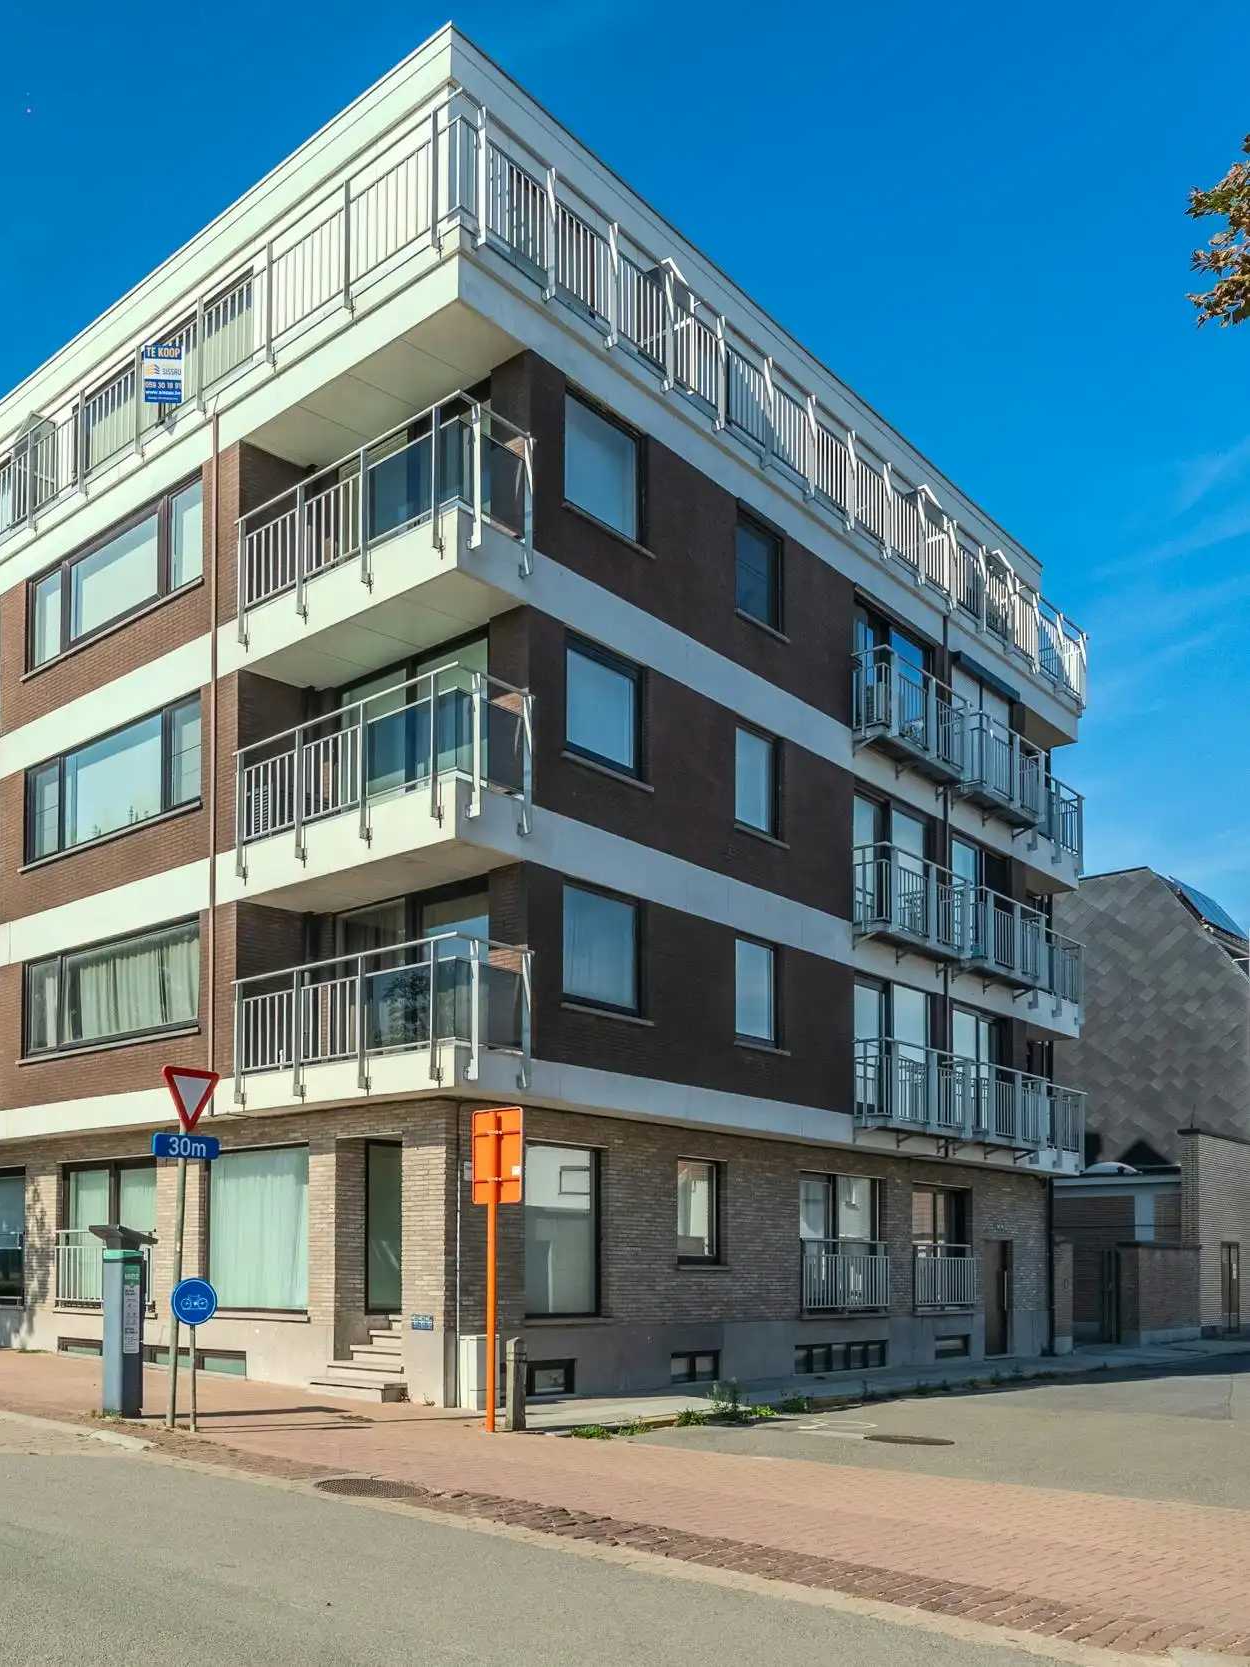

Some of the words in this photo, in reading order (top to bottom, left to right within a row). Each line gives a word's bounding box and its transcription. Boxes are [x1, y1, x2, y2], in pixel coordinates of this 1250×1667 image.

[147, 347, 156, 357] TE
[158, 347, 180, 358] KOOP
[162, 368, 182, 376] SISSAU
[169, 1137, 206, 1157] 30m
